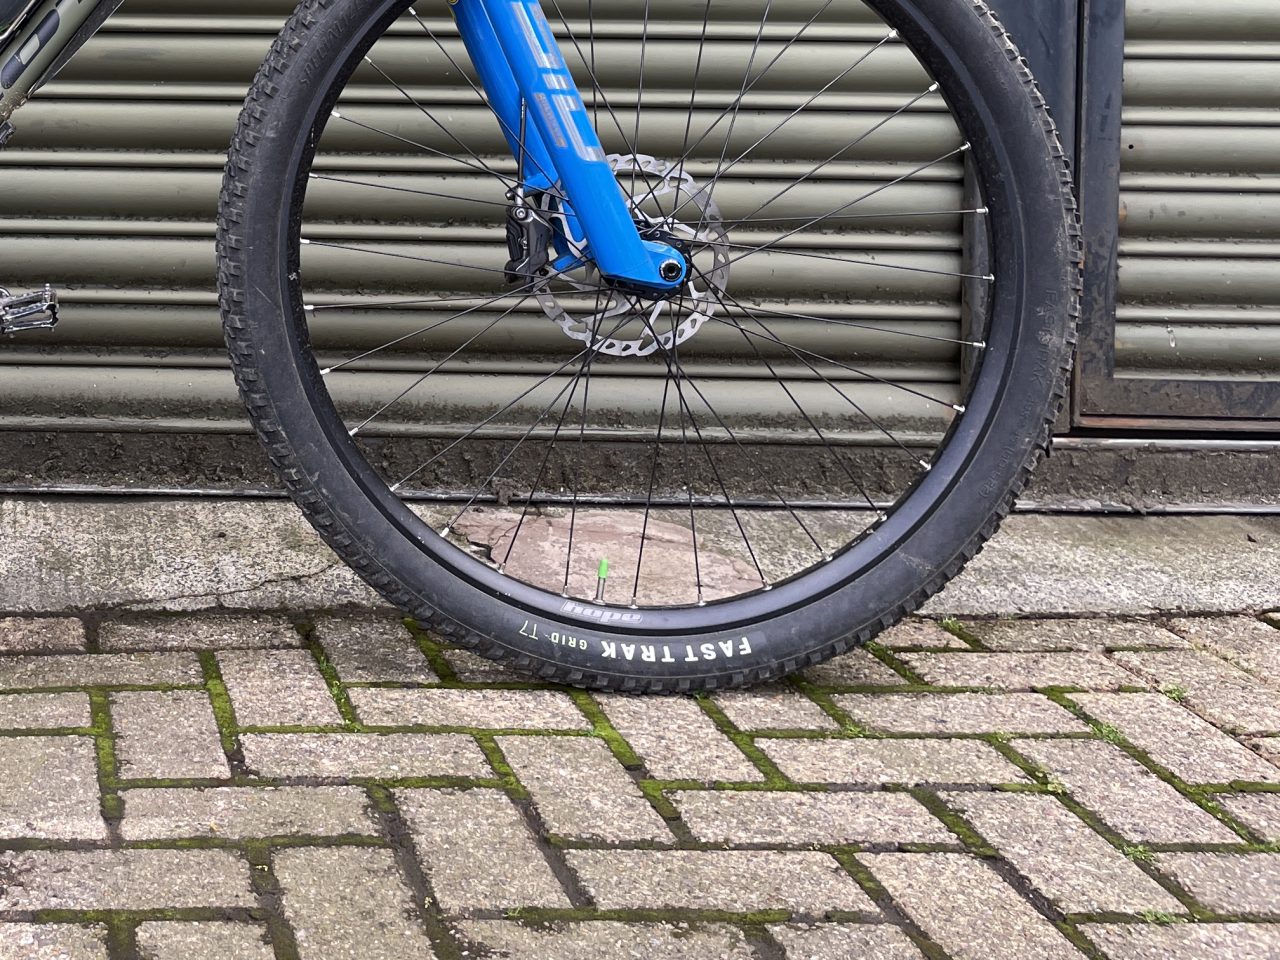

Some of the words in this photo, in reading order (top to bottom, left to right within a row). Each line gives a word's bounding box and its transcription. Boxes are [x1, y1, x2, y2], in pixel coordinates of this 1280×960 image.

[561, 601, 642, 623] hope
[518, 620, 539, 641] T7
[600, 639, 676, 664] TRAK
[684, 636, 752, 662] FAST
